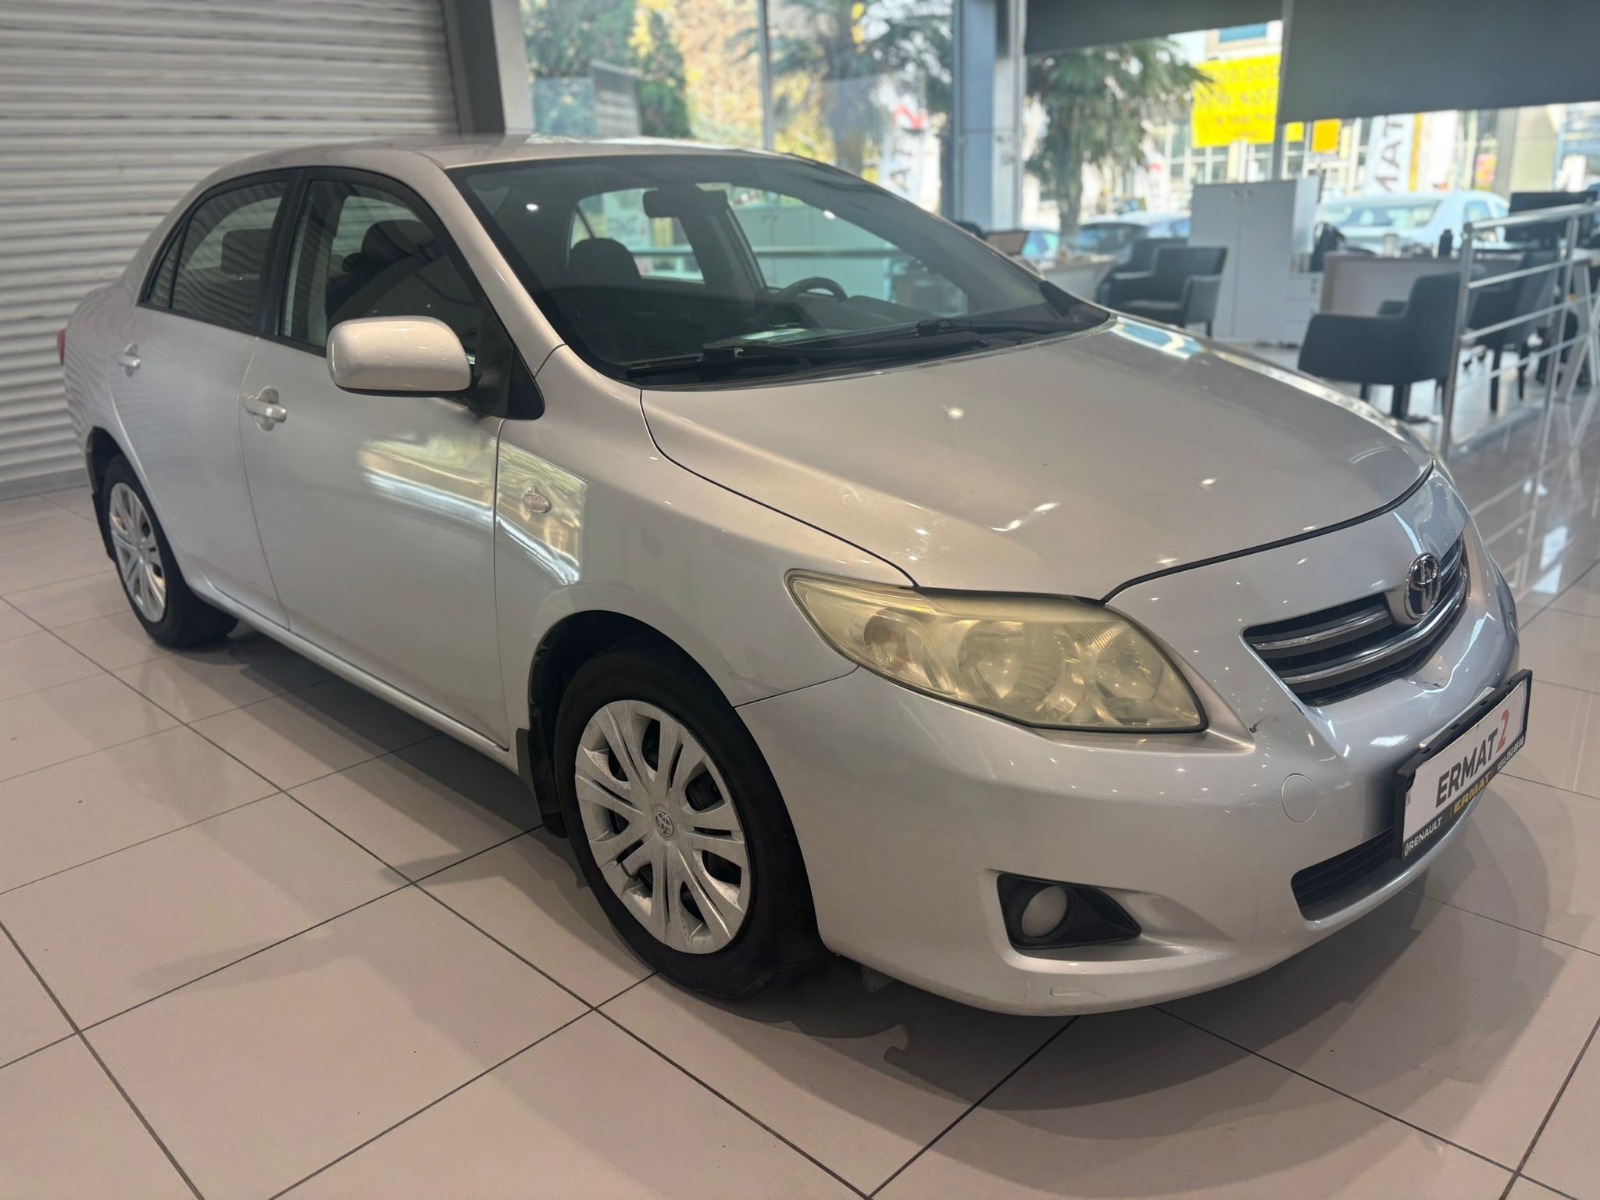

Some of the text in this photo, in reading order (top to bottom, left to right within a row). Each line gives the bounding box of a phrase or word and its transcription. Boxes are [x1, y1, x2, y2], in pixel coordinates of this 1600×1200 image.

[1435, 709, 1509, 808] ERMAT 2
[1453, 770, 1492, 814] ERMAT
[1408, 816, 1443, 851] RENAULT
